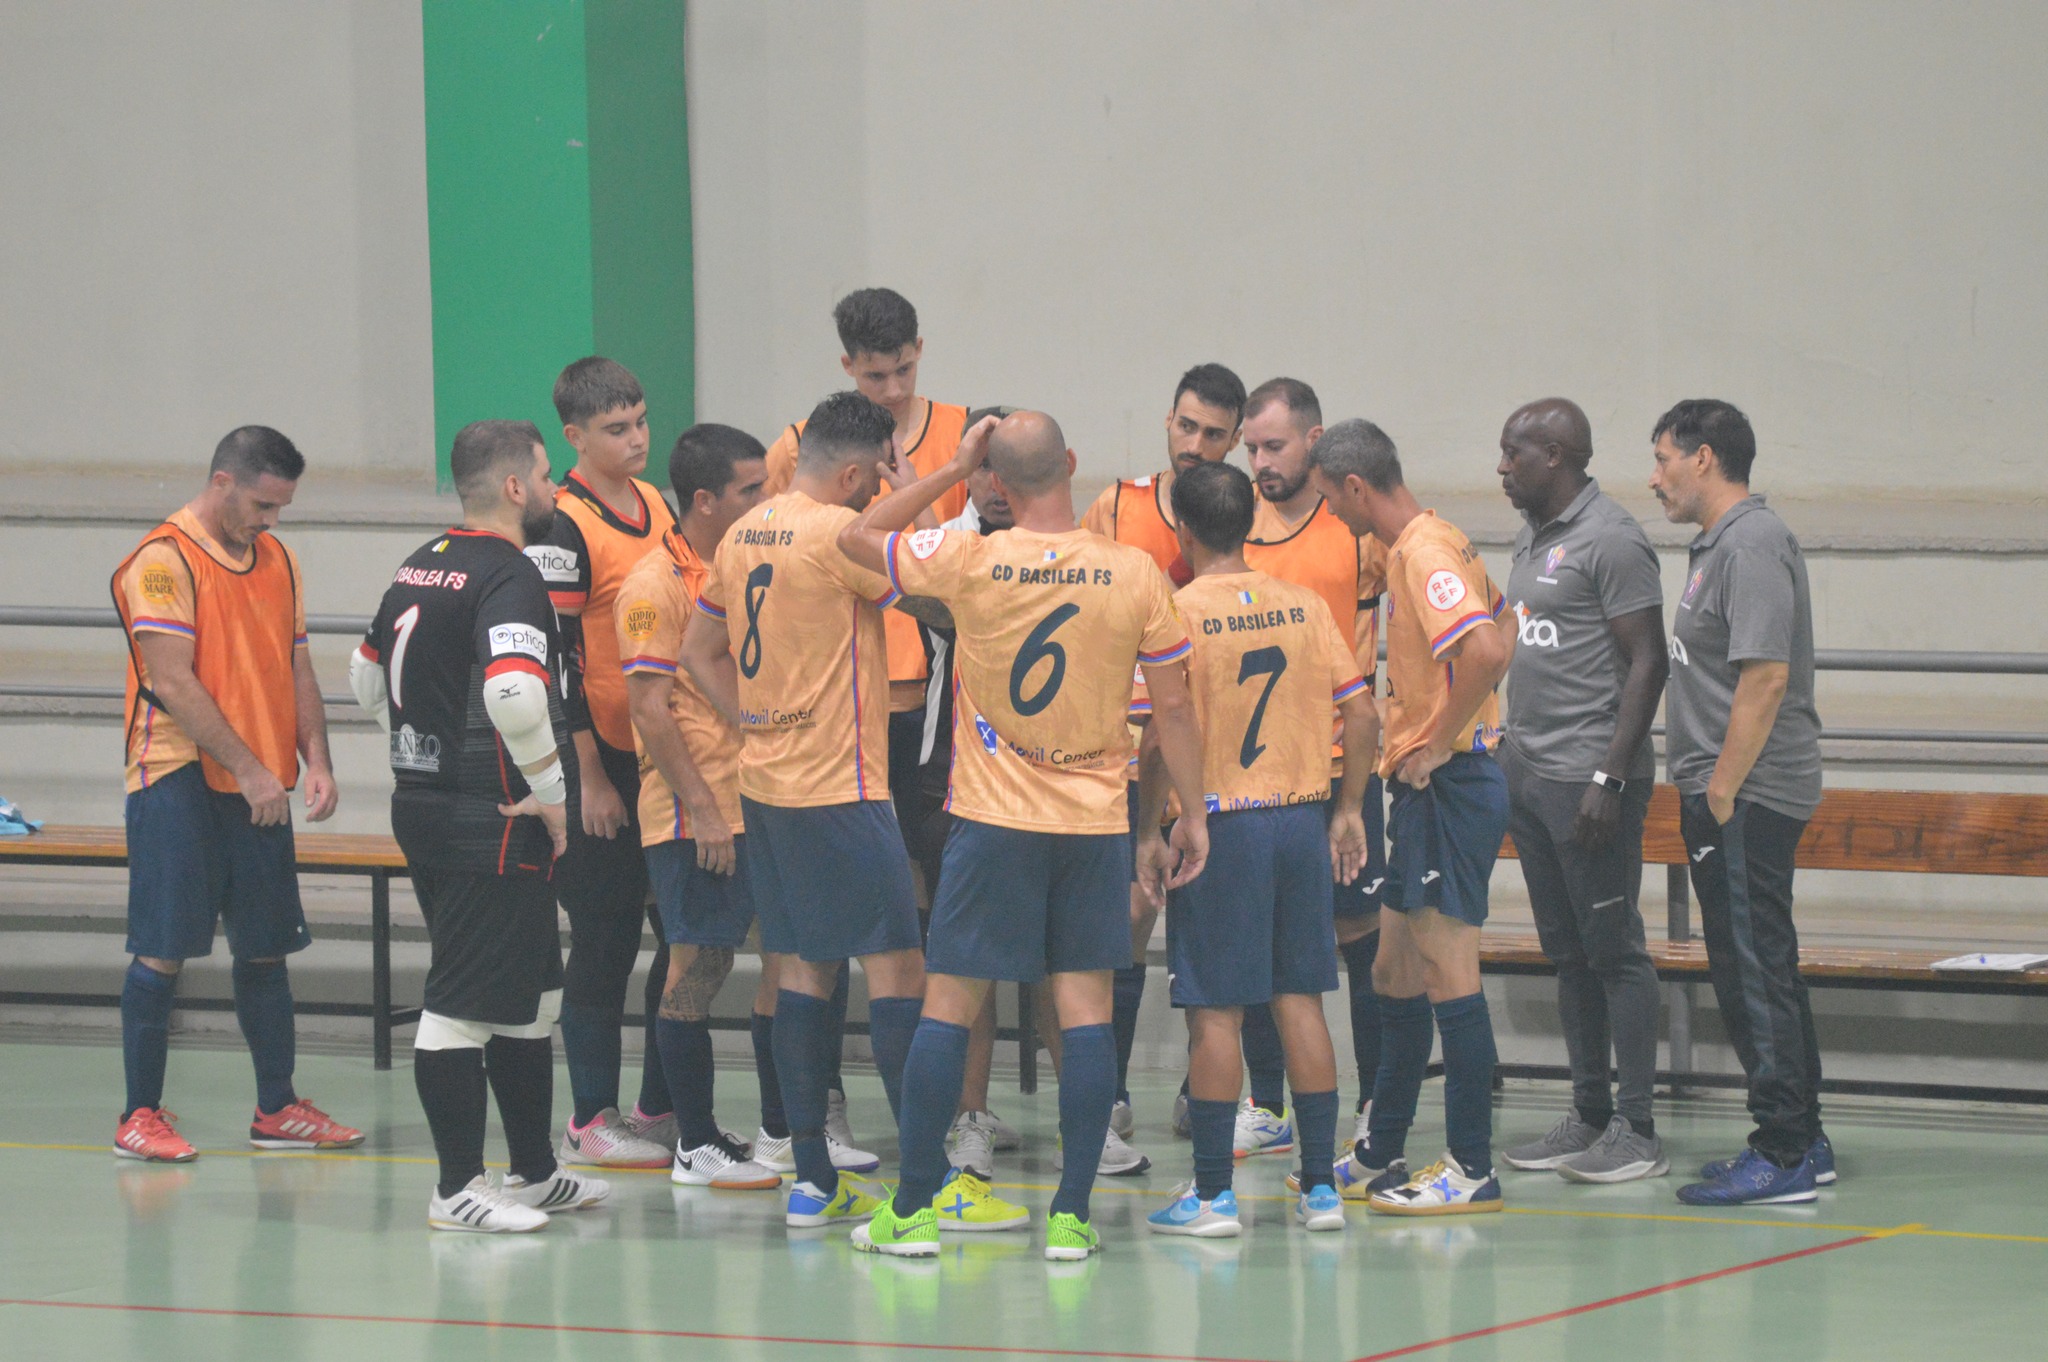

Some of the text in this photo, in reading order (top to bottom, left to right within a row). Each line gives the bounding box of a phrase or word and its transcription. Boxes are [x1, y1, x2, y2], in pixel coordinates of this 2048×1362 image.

[744, 529, 776, 546] BASILEA
[779, 530, 793, 546] FS
[144, 573, 174, 584] ADDIO
[398, 566, 445, 586] BASILEA
[442, 571, 468, 591] FS
[991, 564, 1112, 586] CD BASILEA FS
[144, 583, 174, 595] MARE
[627, 610, 656, 622] ADDIO
[628, 620, 654, 632] MARE
[739, 563, 773, 680] 8
[1203, 607, 1305, 635] CD BASILEA FS
[389, 603, 420, 709] 1
[1009, 602, 1080, 717] 6
[1237, 645, 1287, 770] 7
[1050, 749, 1106, 765] Center
